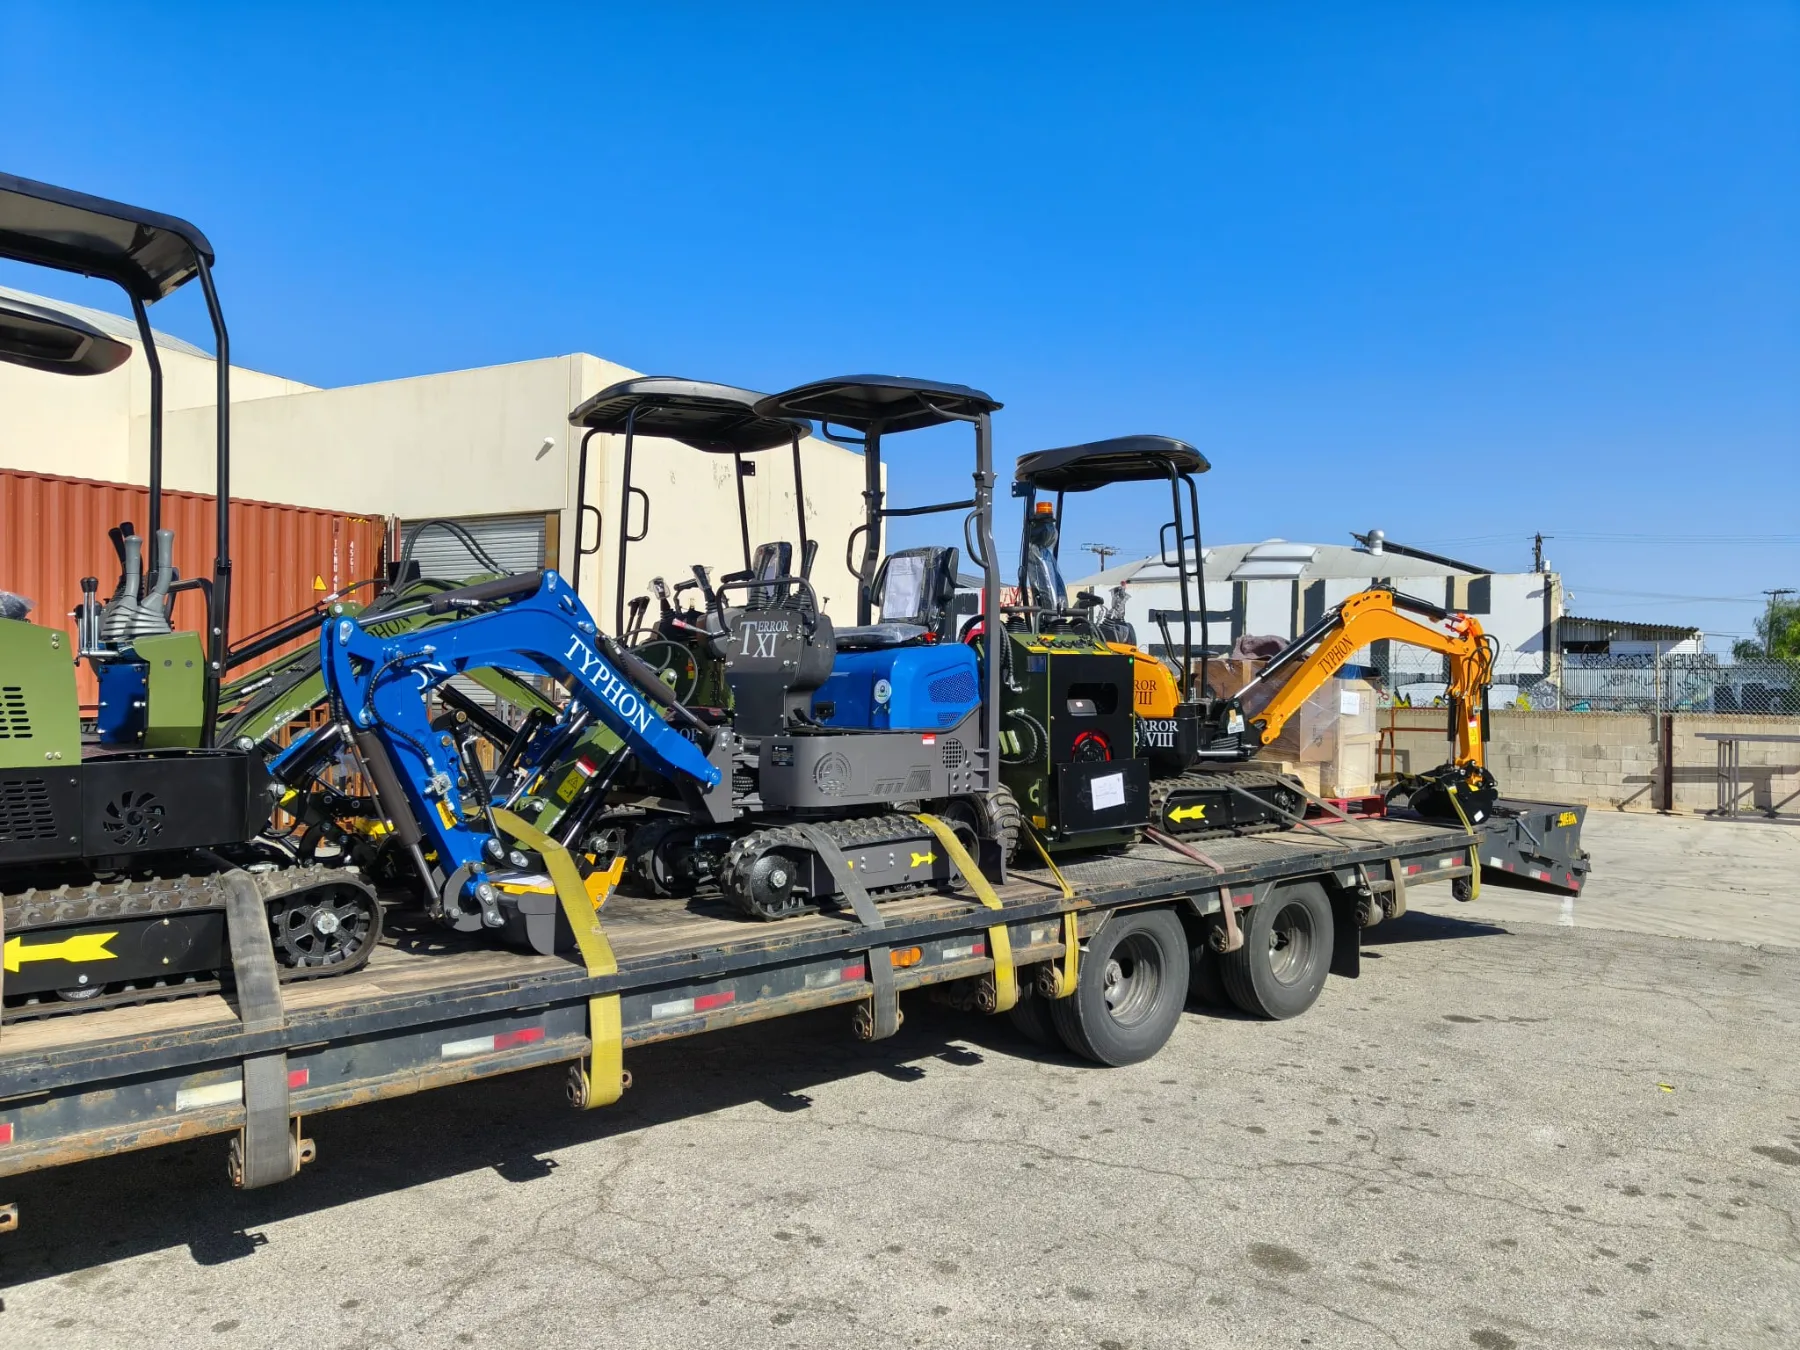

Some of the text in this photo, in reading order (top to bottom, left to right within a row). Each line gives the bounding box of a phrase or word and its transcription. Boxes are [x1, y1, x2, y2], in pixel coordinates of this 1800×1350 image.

[740, 620, 789, 655] TERROR
[752, 632, 779, 658] XI
[1318, 634, 1355, 676] TYPHON
[563, 633, 655, 734] TYPHON
